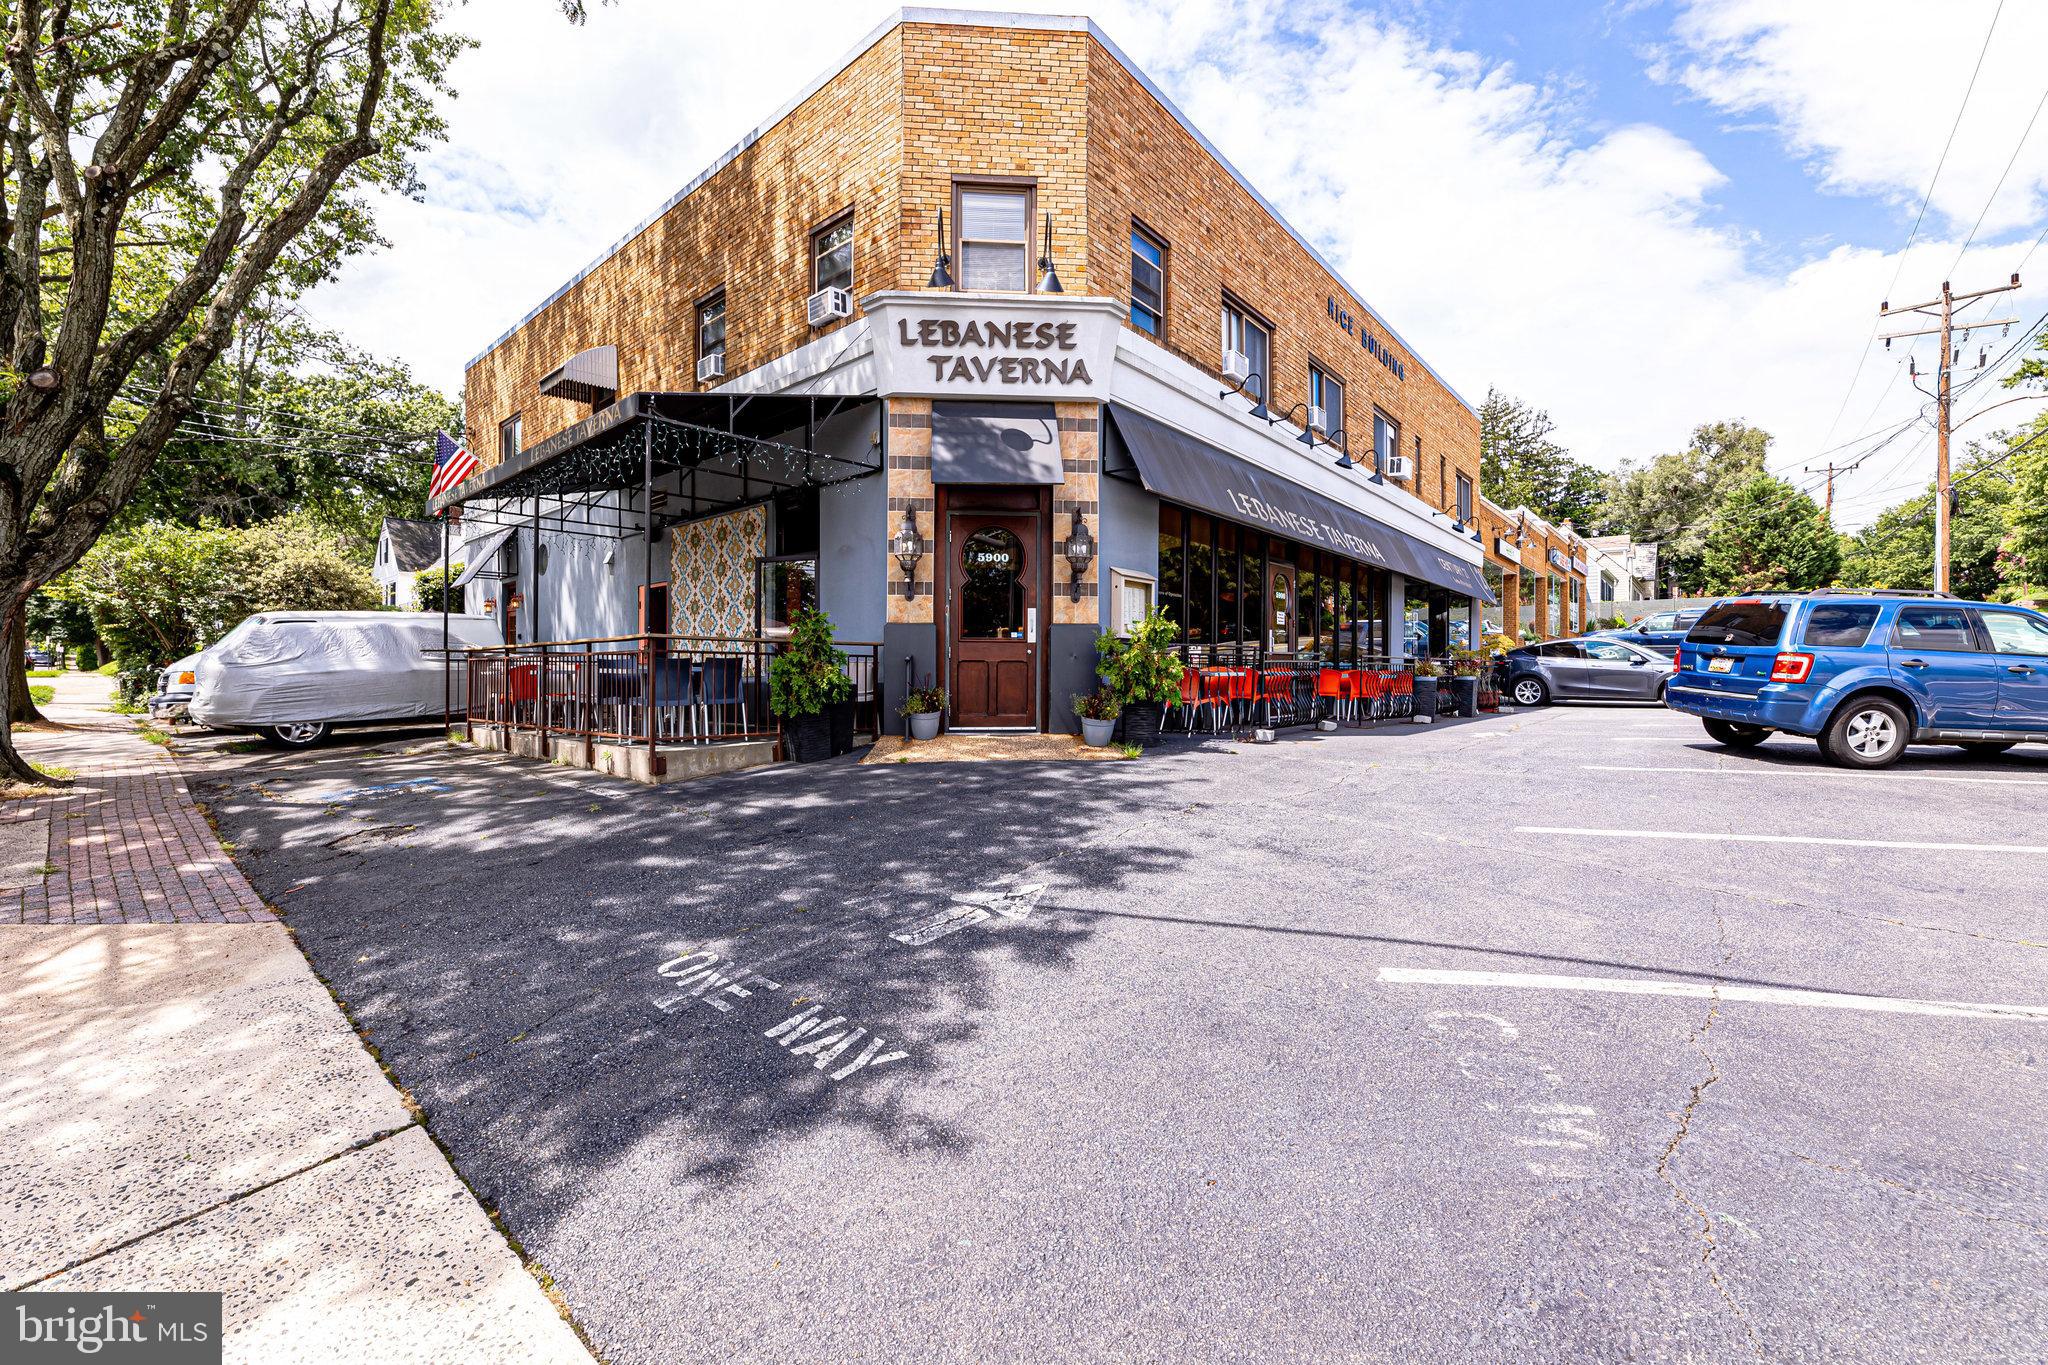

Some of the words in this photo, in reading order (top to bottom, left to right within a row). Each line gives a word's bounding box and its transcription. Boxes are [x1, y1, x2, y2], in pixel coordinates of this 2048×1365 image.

[898, 318, 1078, 350] LEBANESE
[1327, 295, 1354, 336] RICE
[1361, 328, 1405, 382] BUILDING
[927, 355, 1093, 385] TAVERNA
[530, 428, 573, 463] LEBANESE
[575, 404, 622, 440] TAVERNA
[1227, 488, 1325, 541] LEBANESE
[1321, 523, 1386, 563] TAVERNA
[977, 552, 1010, 563] 5900
[653, 951, 782, 1013] ONE
[763, 1004, 910, 1081] WAY
